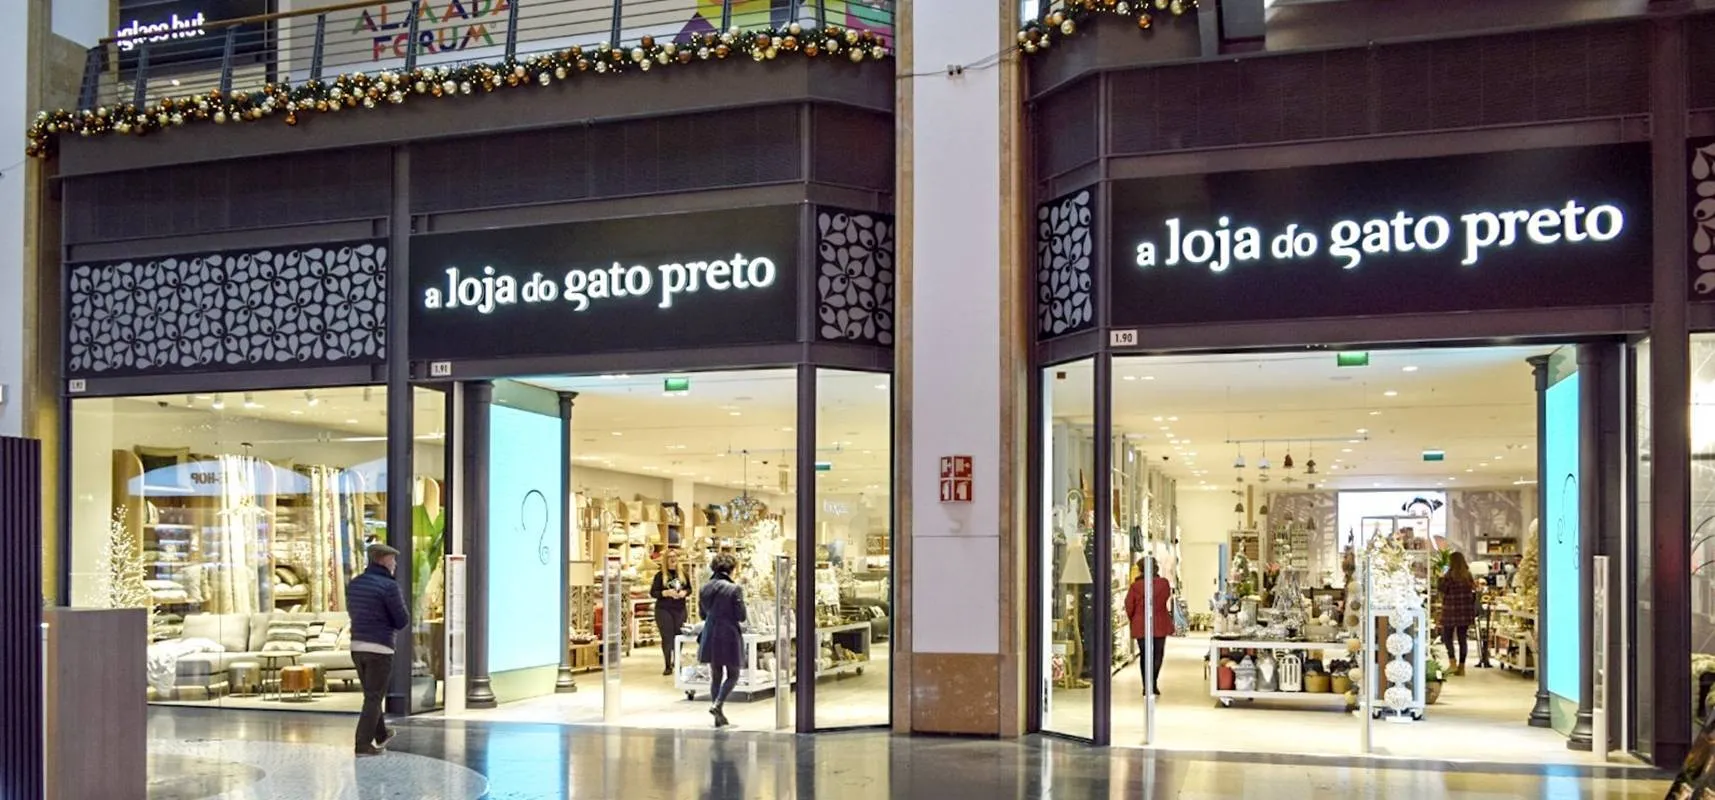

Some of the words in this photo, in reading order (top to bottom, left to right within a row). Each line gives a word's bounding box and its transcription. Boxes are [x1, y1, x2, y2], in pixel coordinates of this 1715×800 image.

[372, 24, 494, 62] FORUM
[1137, 242, 1155, 266] a
[1165, 216, 1260, 272] loja
[1272, 224, 1317, 259] do
[1329, 211, 1450, 269] gato
[1461, 200, 1623, 265] preto
[425, 288, 441, 308] a
[446, 266, 517, 313] loja
[522, 272, 558, 302] do
[564, 262, 653, 311] gato
[658, 253, 775, 308] preto
[1115, 333, 1133, 343] 1.90
